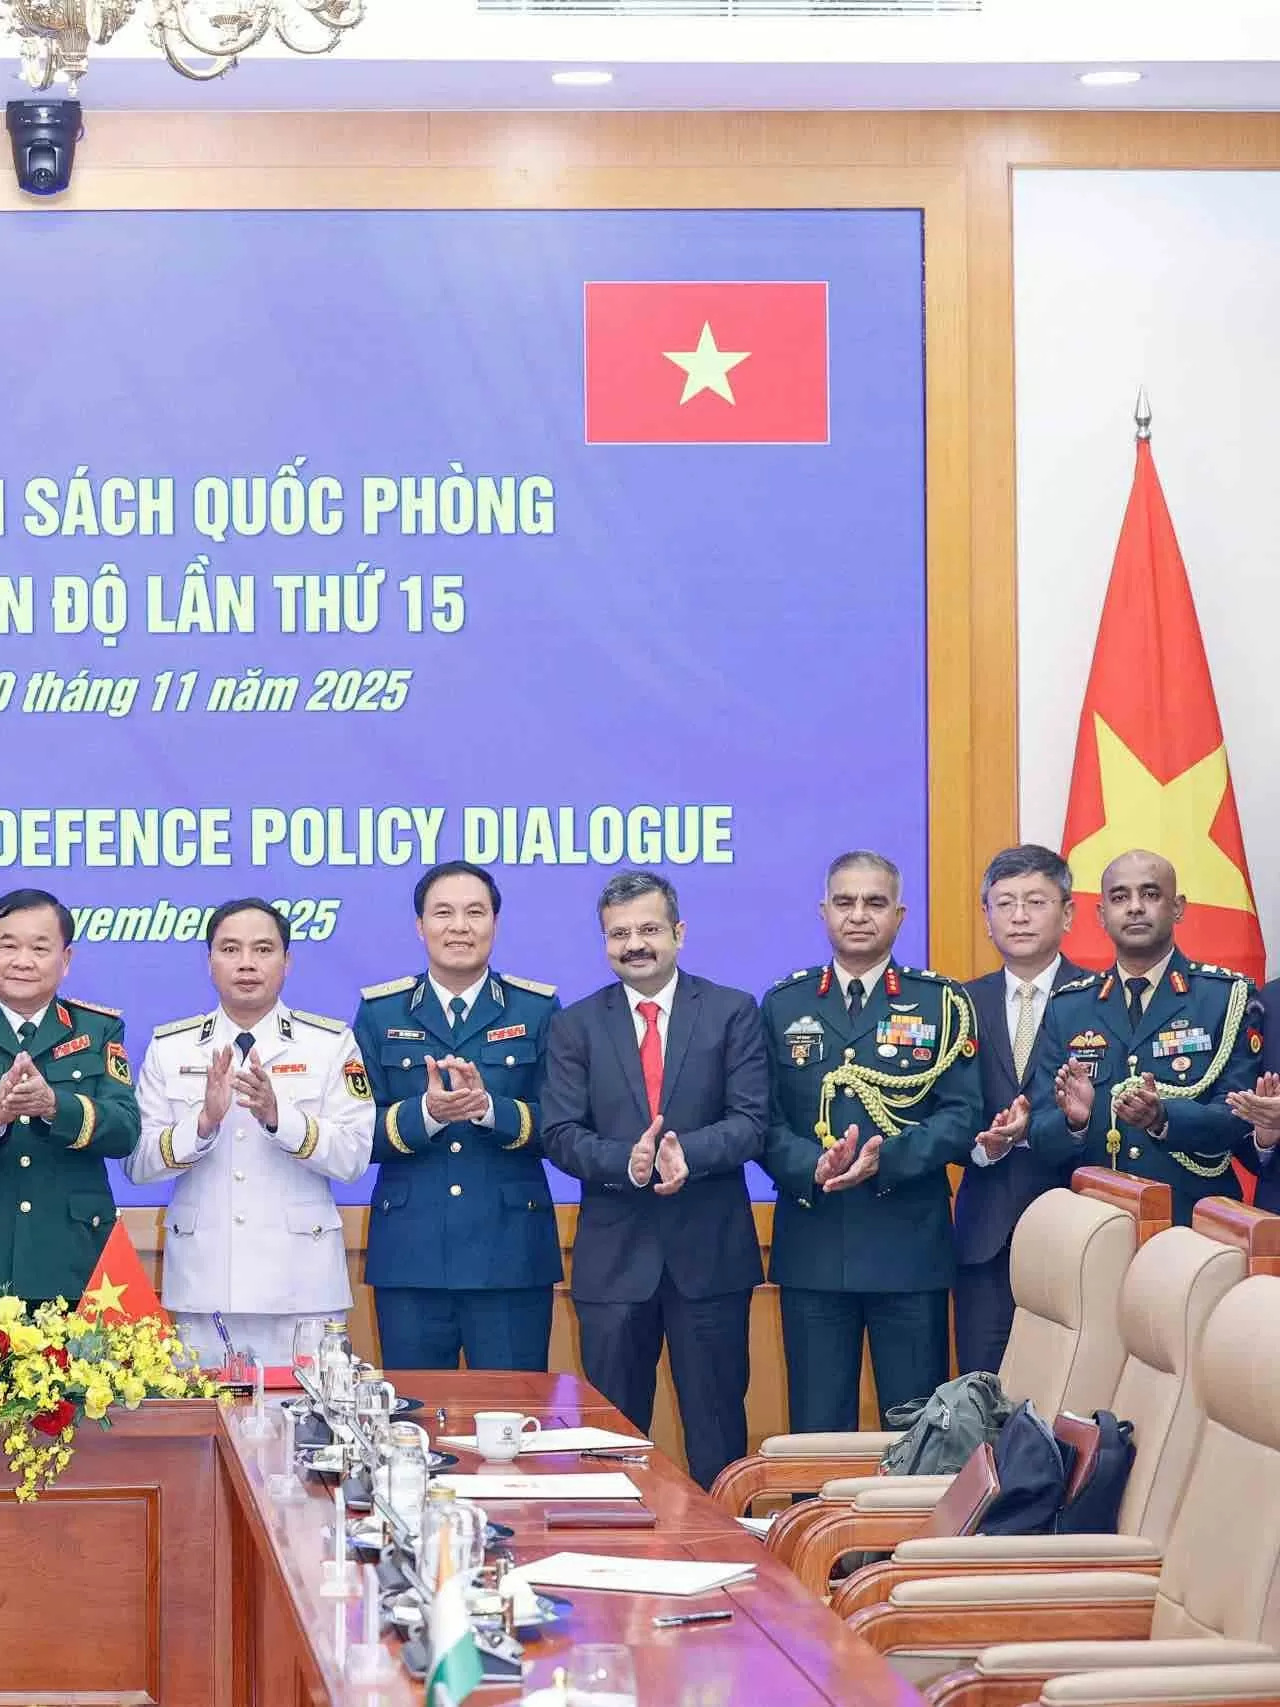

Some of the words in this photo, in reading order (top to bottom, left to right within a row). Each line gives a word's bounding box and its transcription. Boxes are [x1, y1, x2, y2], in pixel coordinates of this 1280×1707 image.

[23, 464, 175, 537] SÁCH
[193, 455, 344, 543] QUỐC
[362, 460, 556, 536] PHÒNG
[51, 564, 128, 648] ĐỘ
[147, 554, 256, 634] LẦN
[272, 561, 385, 634] THỨ
[399, 574, 466, 633] 15
[22, 670, 139, 718] tháng
[150, 671, 198, 712] 11
[206, 669, 300, 713] năm
[305, 670, 412, 712] 2025
[251, 807, 446, 867] POLICY
[463, 805, 734, 866] DIALOGUE
